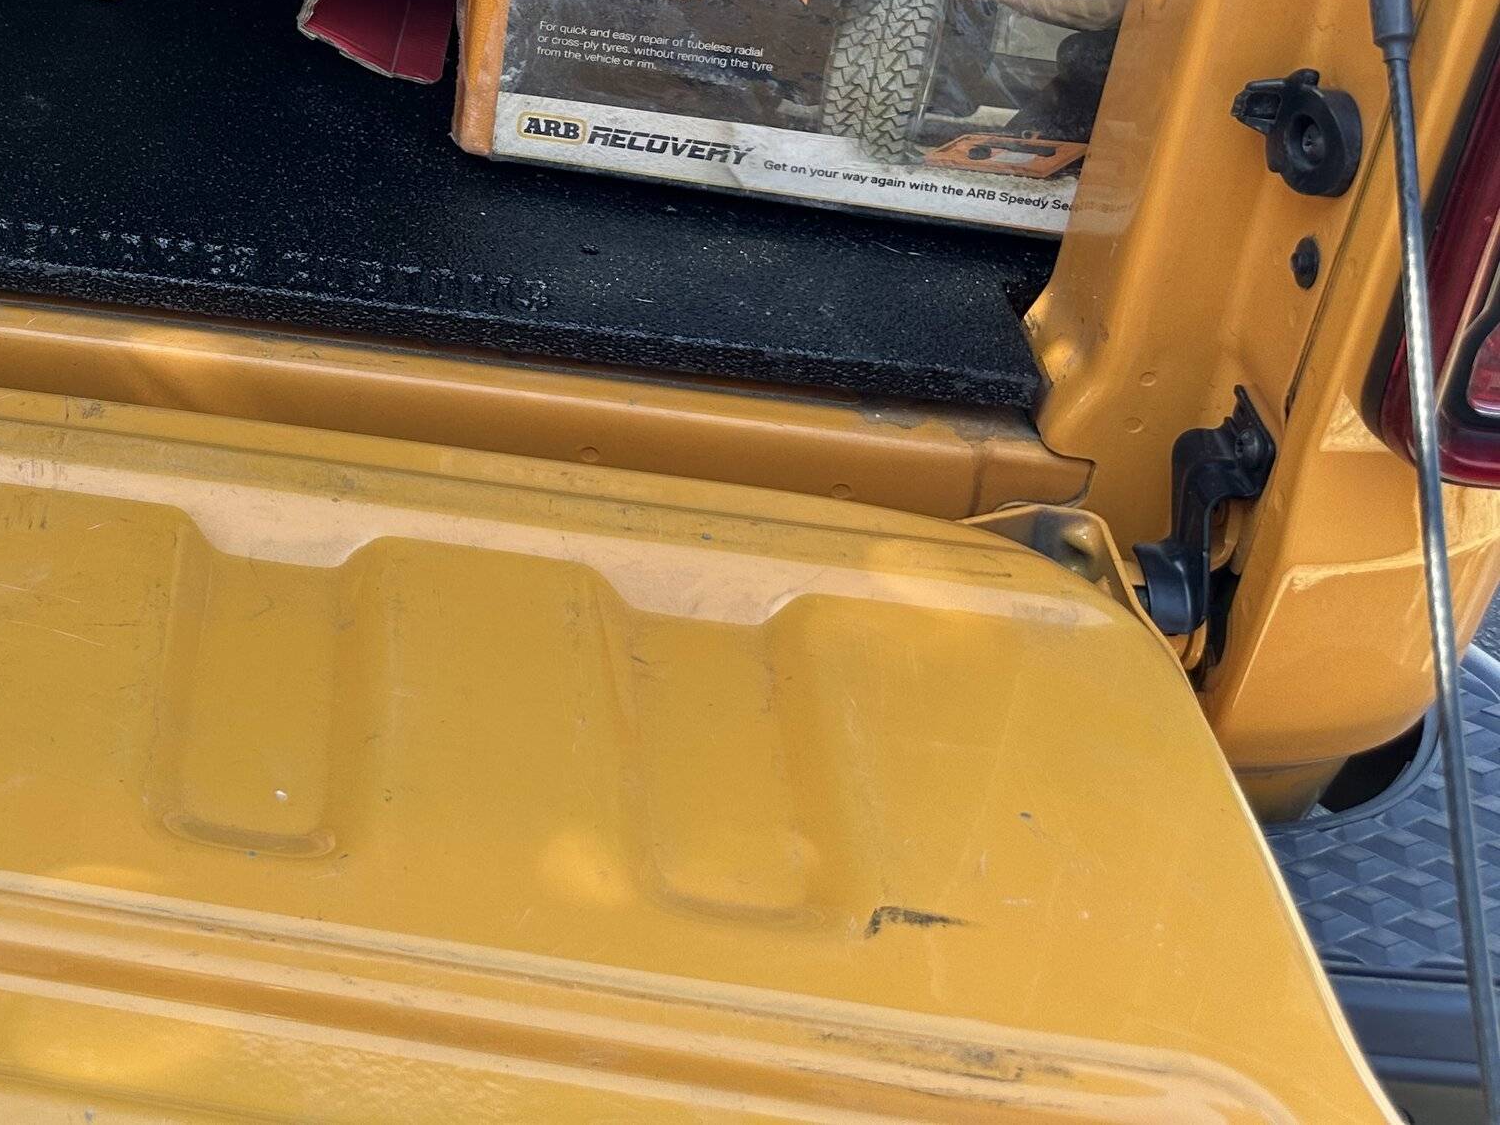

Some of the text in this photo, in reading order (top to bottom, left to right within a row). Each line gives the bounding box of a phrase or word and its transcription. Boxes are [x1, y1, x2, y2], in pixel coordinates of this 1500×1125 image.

[536, 46, 561, 57] from
[564, 49, 581, 60] the
[584, 53, 620, 65] vehicle
[623, 58, 635, 67] or
[537, 35, 548, 43] or
[551, 36, 599, 50] cross-ply
[634, 47, 675, 60] without
[677, 52, 727, 68] removing
[730, 58, 748, 69] the
[751, 61, 774, 73] tyre
[539, 21, 764, 57] For quick and easy repair of tubeless radial
[523, 117, 755, 165] ARB RECOVERY
[763, 160, 788, 173] Get
[790, 164, 806, 175] on
[809, 167, 839, 181] your
[841, 171, 867, 184] way
[870, 175, 906, 191] again
[909, 180, 939, 194] with
[941, 184, 964, 198] the
[966, 187, 996, 202] ARB
[998, 192, 1049, 209] Speedy
